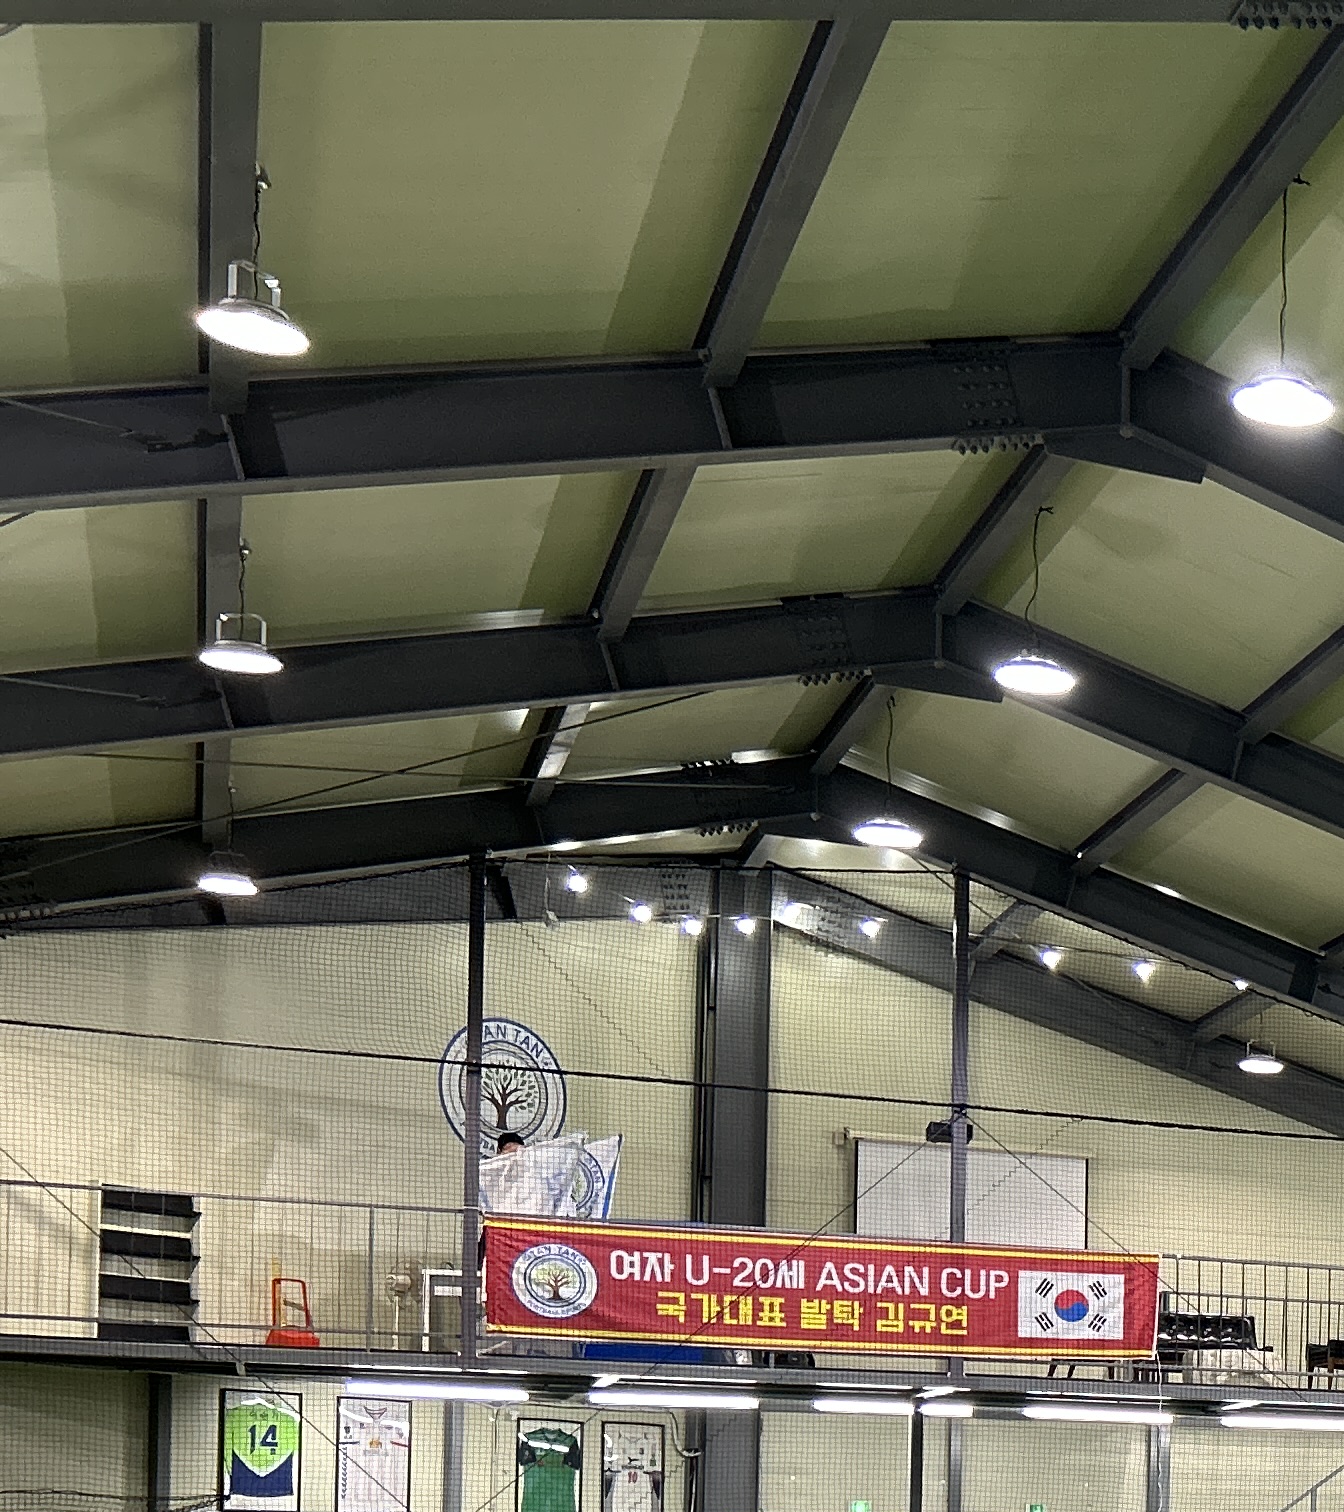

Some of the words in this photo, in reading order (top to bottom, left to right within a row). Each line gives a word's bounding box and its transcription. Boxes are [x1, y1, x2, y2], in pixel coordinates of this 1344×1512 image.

[609, 1249, 675, 1283] 여자
[685, 1253, 805, 1290] U-20세
[815, 1261, 929, 1296] ASIAN
[940, 1267, 1010, 1300] CUP
[655, 1290, 787, 1328] 국가대표
[800, 1298, 863, 1331] 발탁
[876, 1301, 968, 1336] 김규연
[248, 1424, 279, 1456] 14
